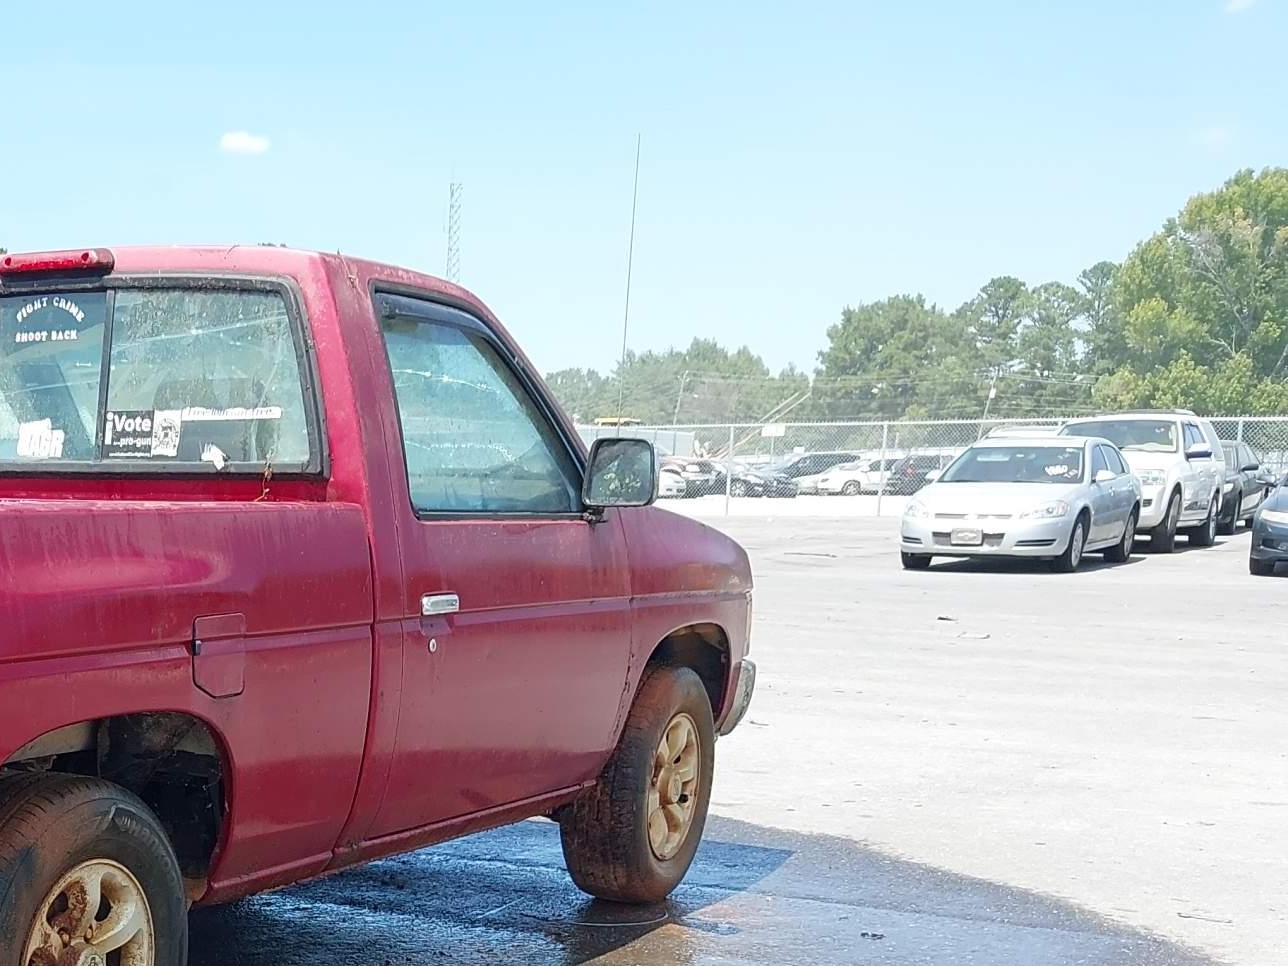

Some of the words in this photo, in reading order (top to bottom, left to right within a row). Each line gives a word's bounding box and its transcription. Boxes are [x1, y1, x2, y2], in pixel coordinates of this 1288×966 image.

[16, 297, 48, 323] FIGHT
[53, 296, 85, 322] CRIME
[15, 330, 48, 343] SHOOT
[51, 329, 78, 341] BACK
